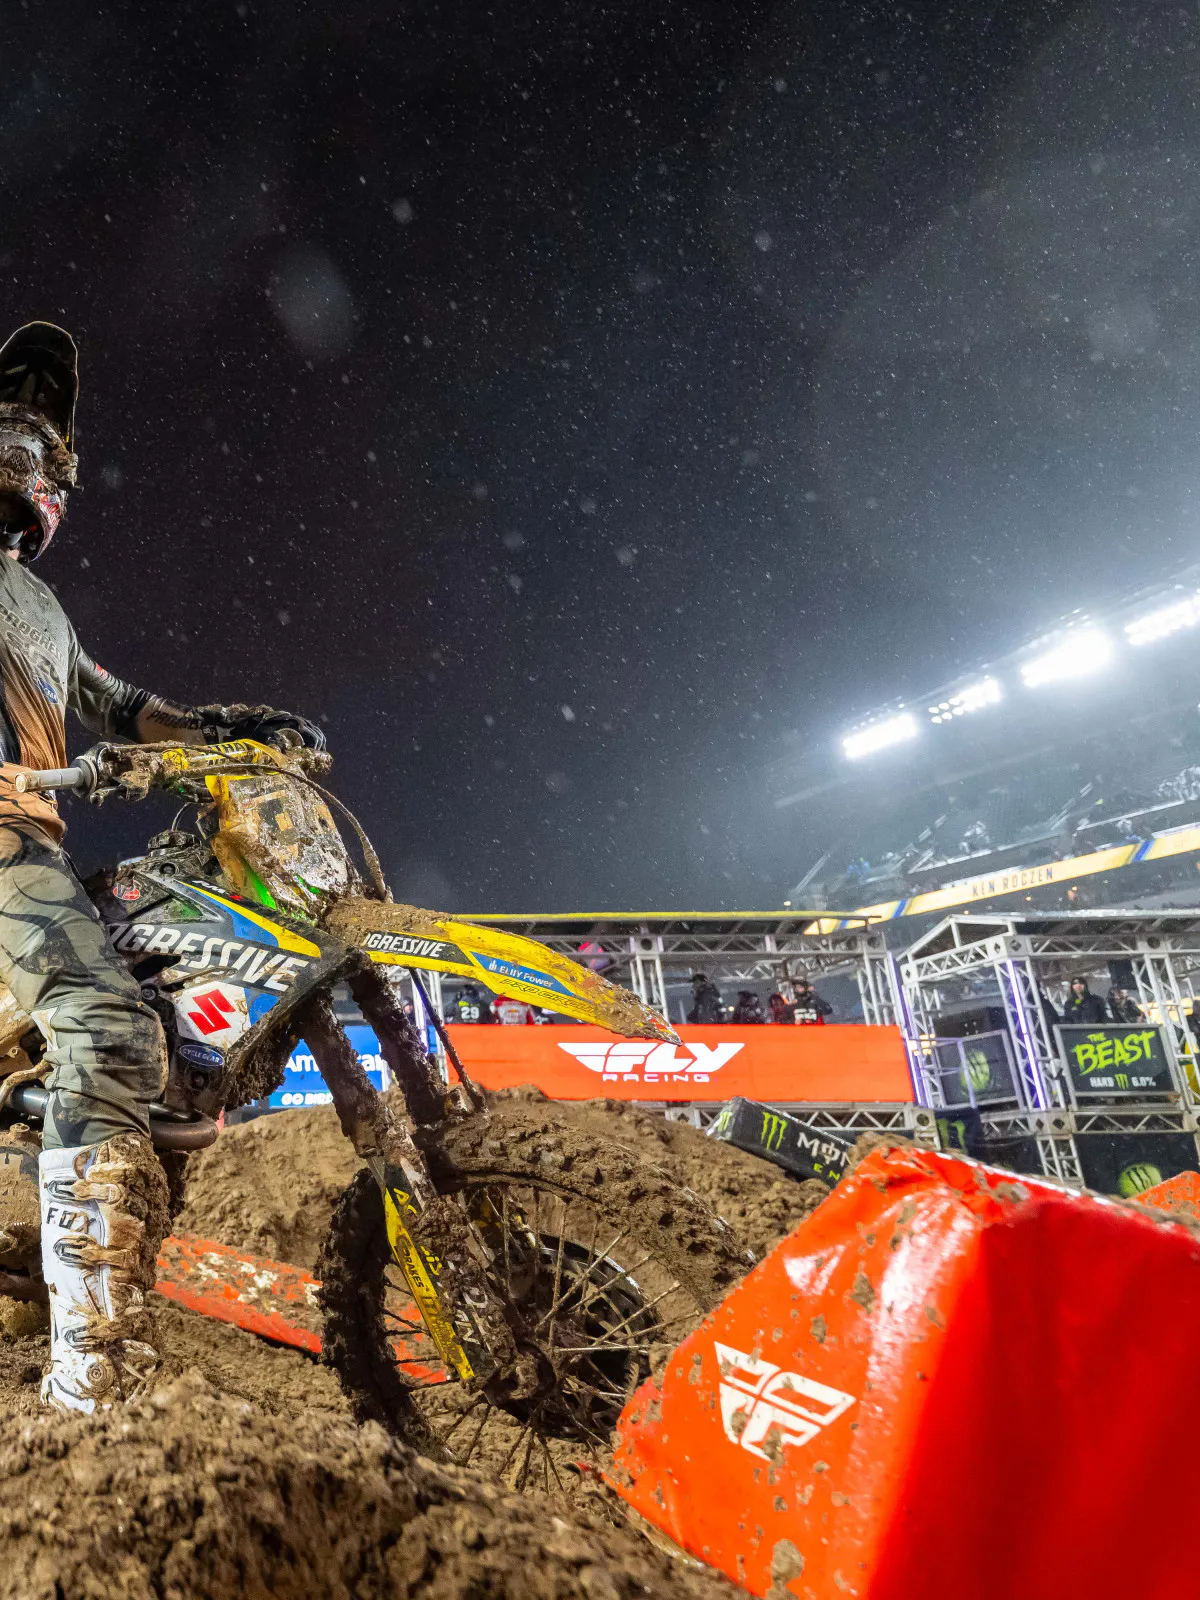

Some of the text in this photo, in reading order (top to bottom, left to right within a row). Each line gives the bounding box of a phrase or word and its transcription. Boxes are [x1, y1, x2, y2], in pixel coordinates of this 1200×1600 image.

[972, 867, 1053, 897] KEN ROCZEN
[523, 972, 554, 988] Power
[461, 1006, 480, 1019] 29
[1087, 1032, 1107, 1043] THE
[201, 1053, 220, 1063] GEAR
[557, 1042, 745, 1073] FLY
[1072, 1030, 1156, 1075] BEAST
[602, 1073, 710, 1083] RACING
[1089, 1076, 1115, 1088] HARD
[281, 1092, 305, 1106] GO
[45, 1207, 97, 1234] FOX
